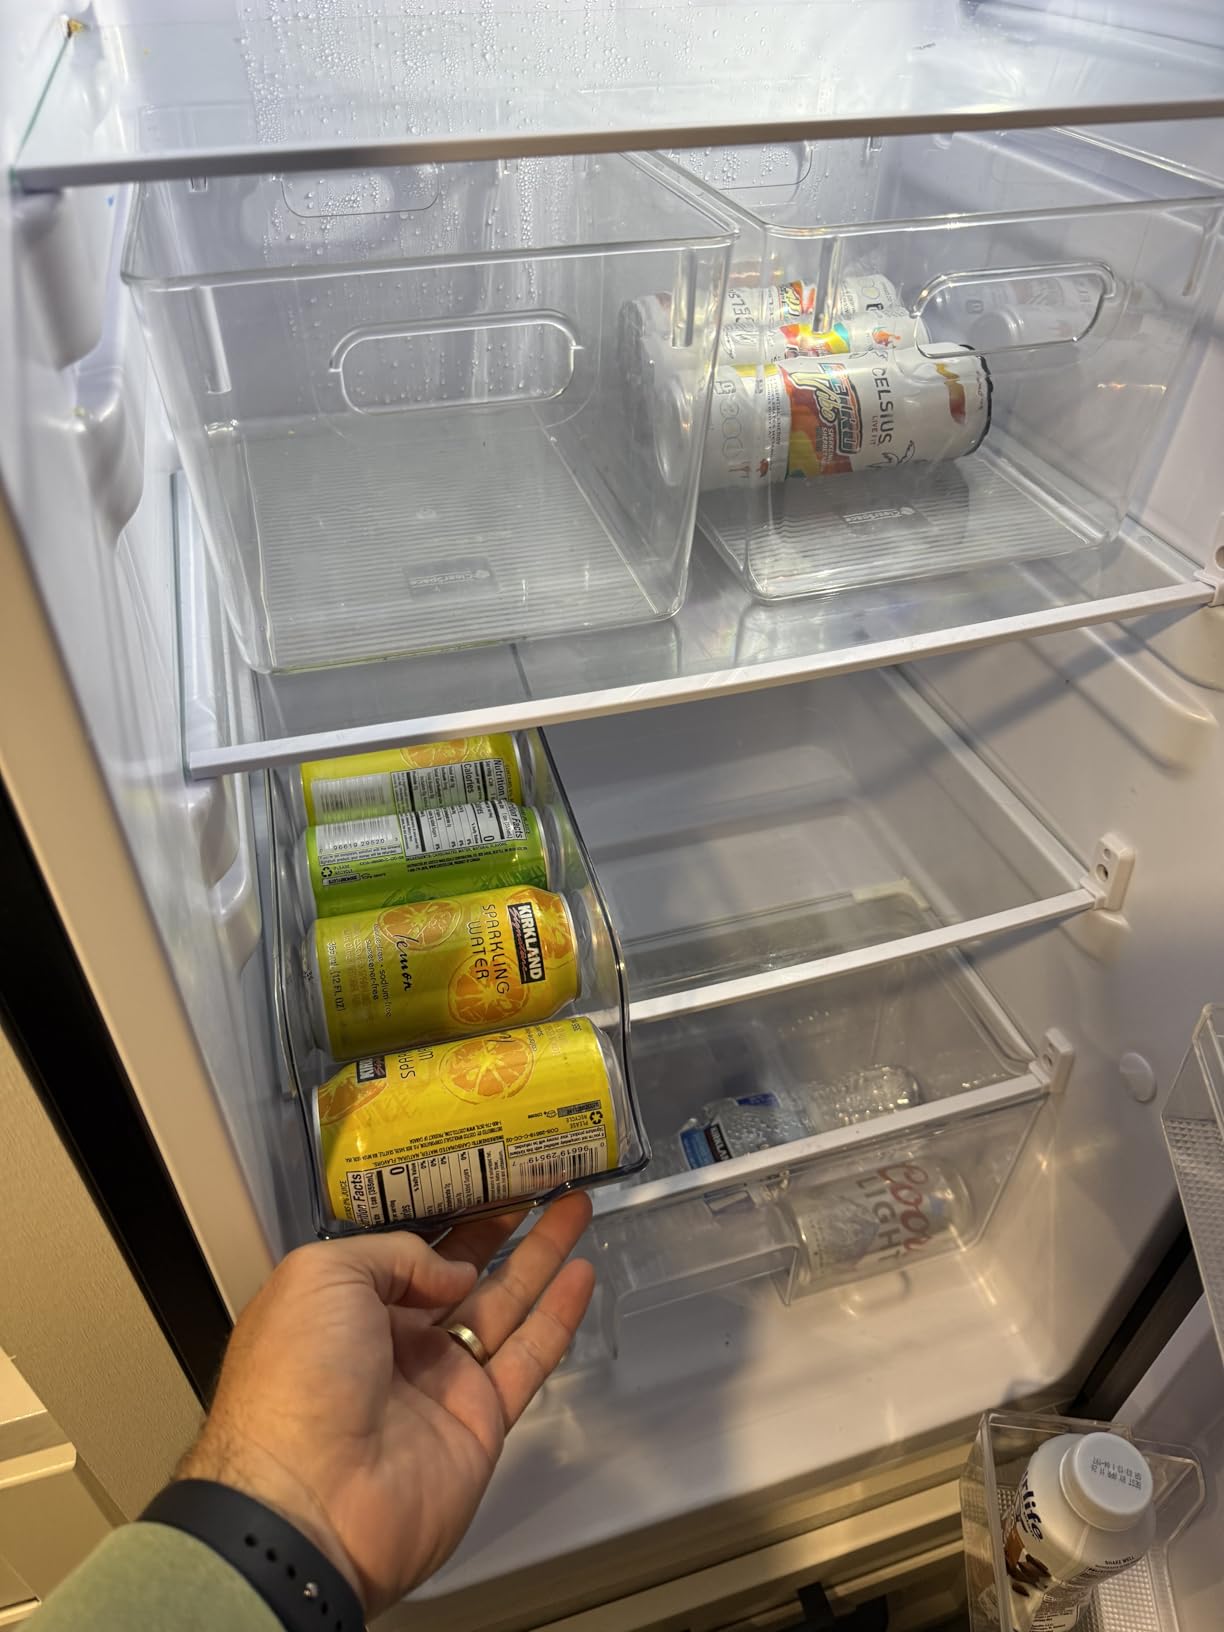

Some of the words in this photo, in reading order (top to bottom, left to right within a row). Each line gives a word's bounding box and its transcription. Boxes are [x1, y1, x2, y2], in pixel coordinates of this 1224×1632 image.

[871, 367, 894, 445] CELSIUS
[463, 763, 475, 793] Calories
[493, 759, 506, 796] Nutrition
[511, 817, 523, 838] Facts
[466, 920, 490, 980] WATER
[482, 904, 510, 995] SPARKLING
[517, 905, 543, 980] KIRKLAND
[364, 939, 379, 1001] sweetener-free
[394, 935, 419, 992] lemon
[565, 1113, 587, 1123] RECYCLE
[569, 1120, 588, 1128] PLEASE
[438, 1142, 470, 1153] CARBONATED
[459, 1151, 467, 1160] 0%
[559, 1144, 589, 1156] 96619
[397, 1152, 419, 1162] NATURAL
[419, 1160, 426, 1169] 0%
[429, 1157, 437, 1167] 0%
[439, 1155, 447, 1165] 0%
[527, 1151, 557, 1163] 29519
[388, 1165, 405, 1176] 0
[409, 1162, 417, 1175] Value
[339, 1179, 349, 1197] JUICE
[348, 1172, 366, 1203] Facts
[364, 1171, 378, 1195] (355mL)
[411, 1175, 420, 1187] Daily
[879, 1161, 932, 1255] Coor
[857, 1177, 902, 1262] LIGHT
